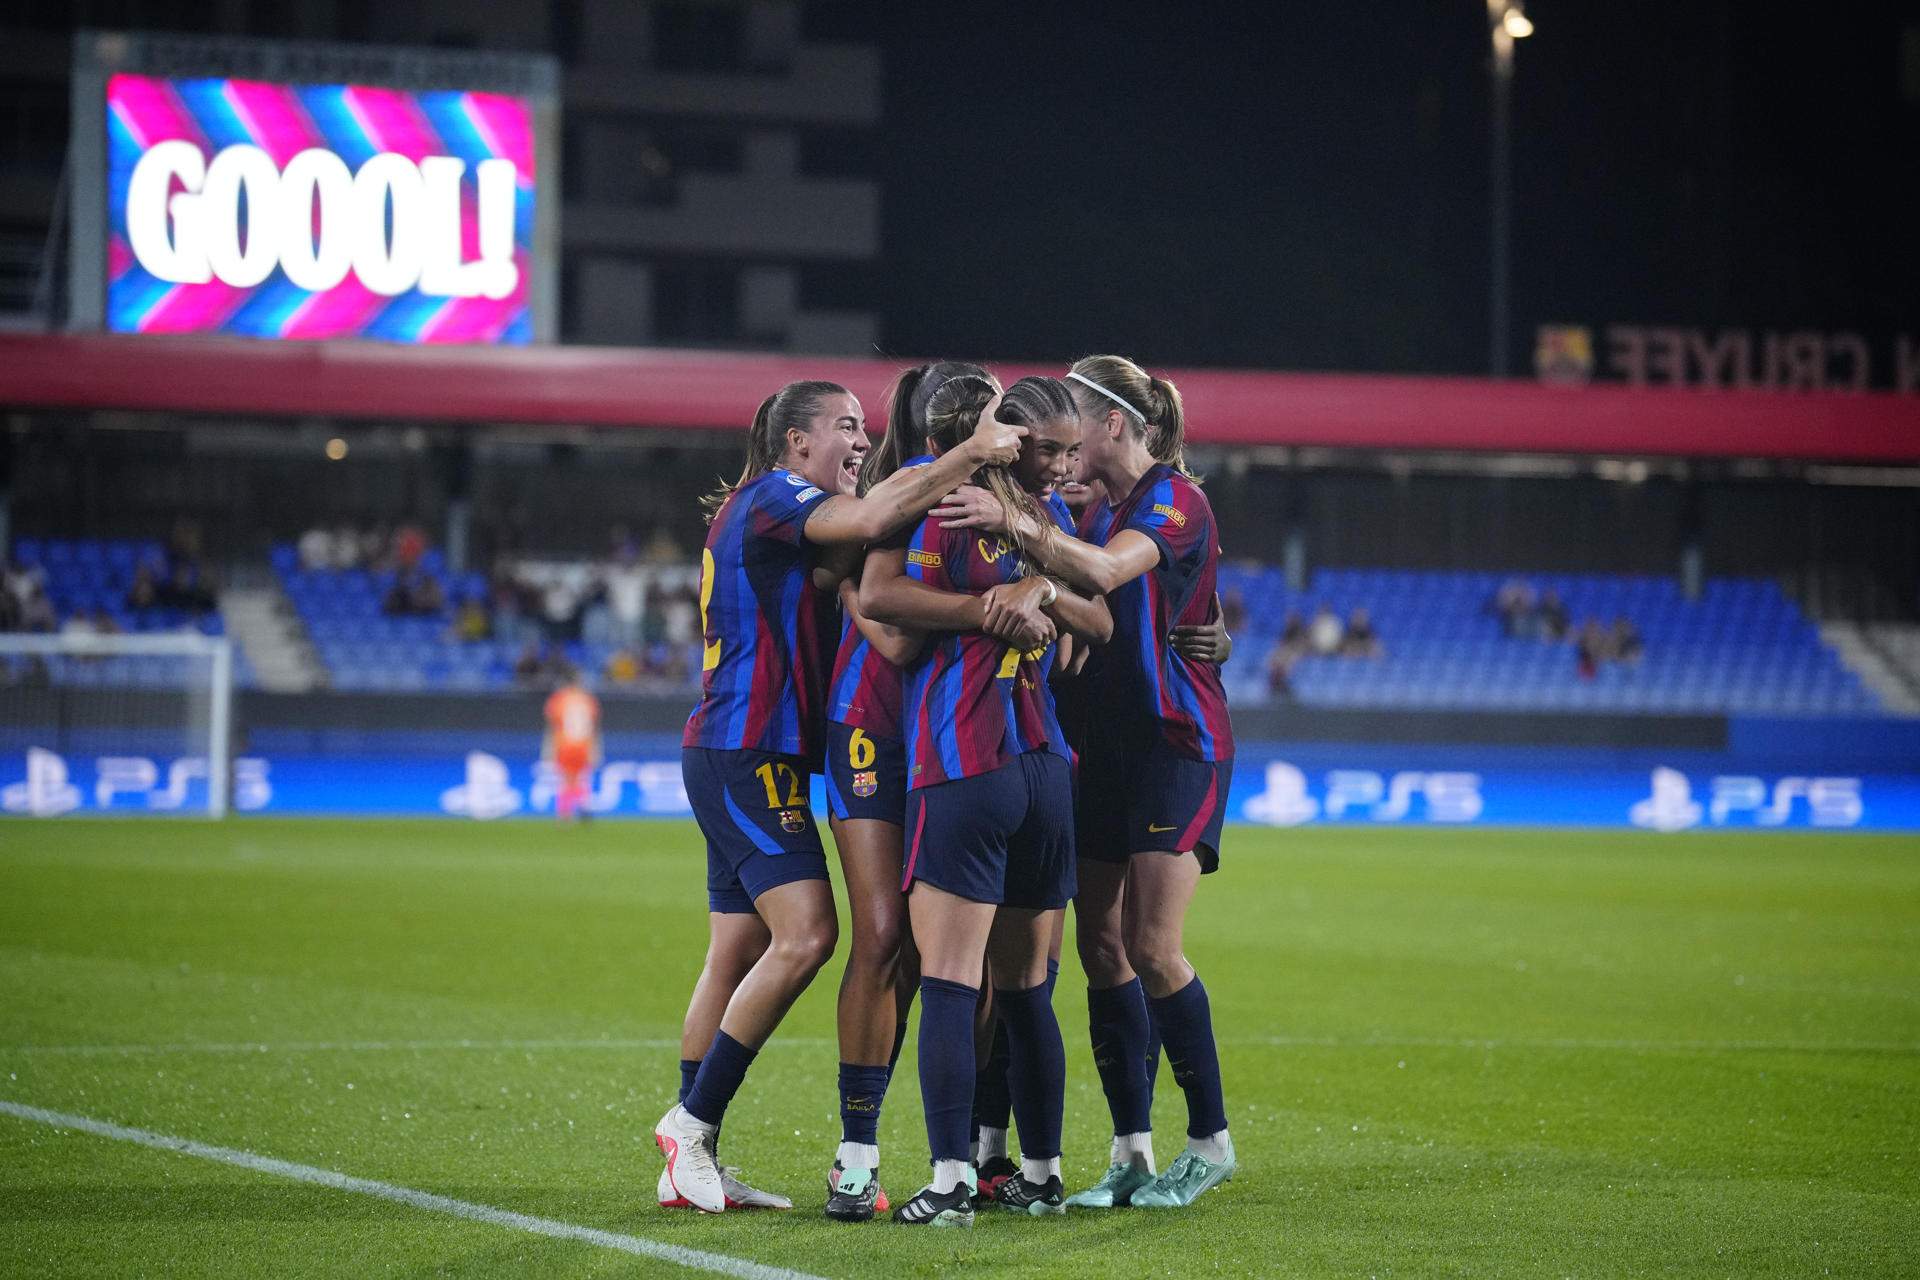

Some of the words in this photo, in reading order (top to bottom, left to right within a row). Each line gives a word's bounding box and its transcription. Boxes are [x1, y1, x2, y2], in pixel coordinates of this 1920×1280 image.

[127, 140, 518, 299] GOOOL!
[1153, 503, 1186, 527] BIMBO
[908, 553, 942, 566] BIMBO
[849, 727, 876, 769] 6
[755, 761, 806, 809] 12
[1324, 769, 1483, 823] PS5
[1710, 775, 1864, 827] PS5
